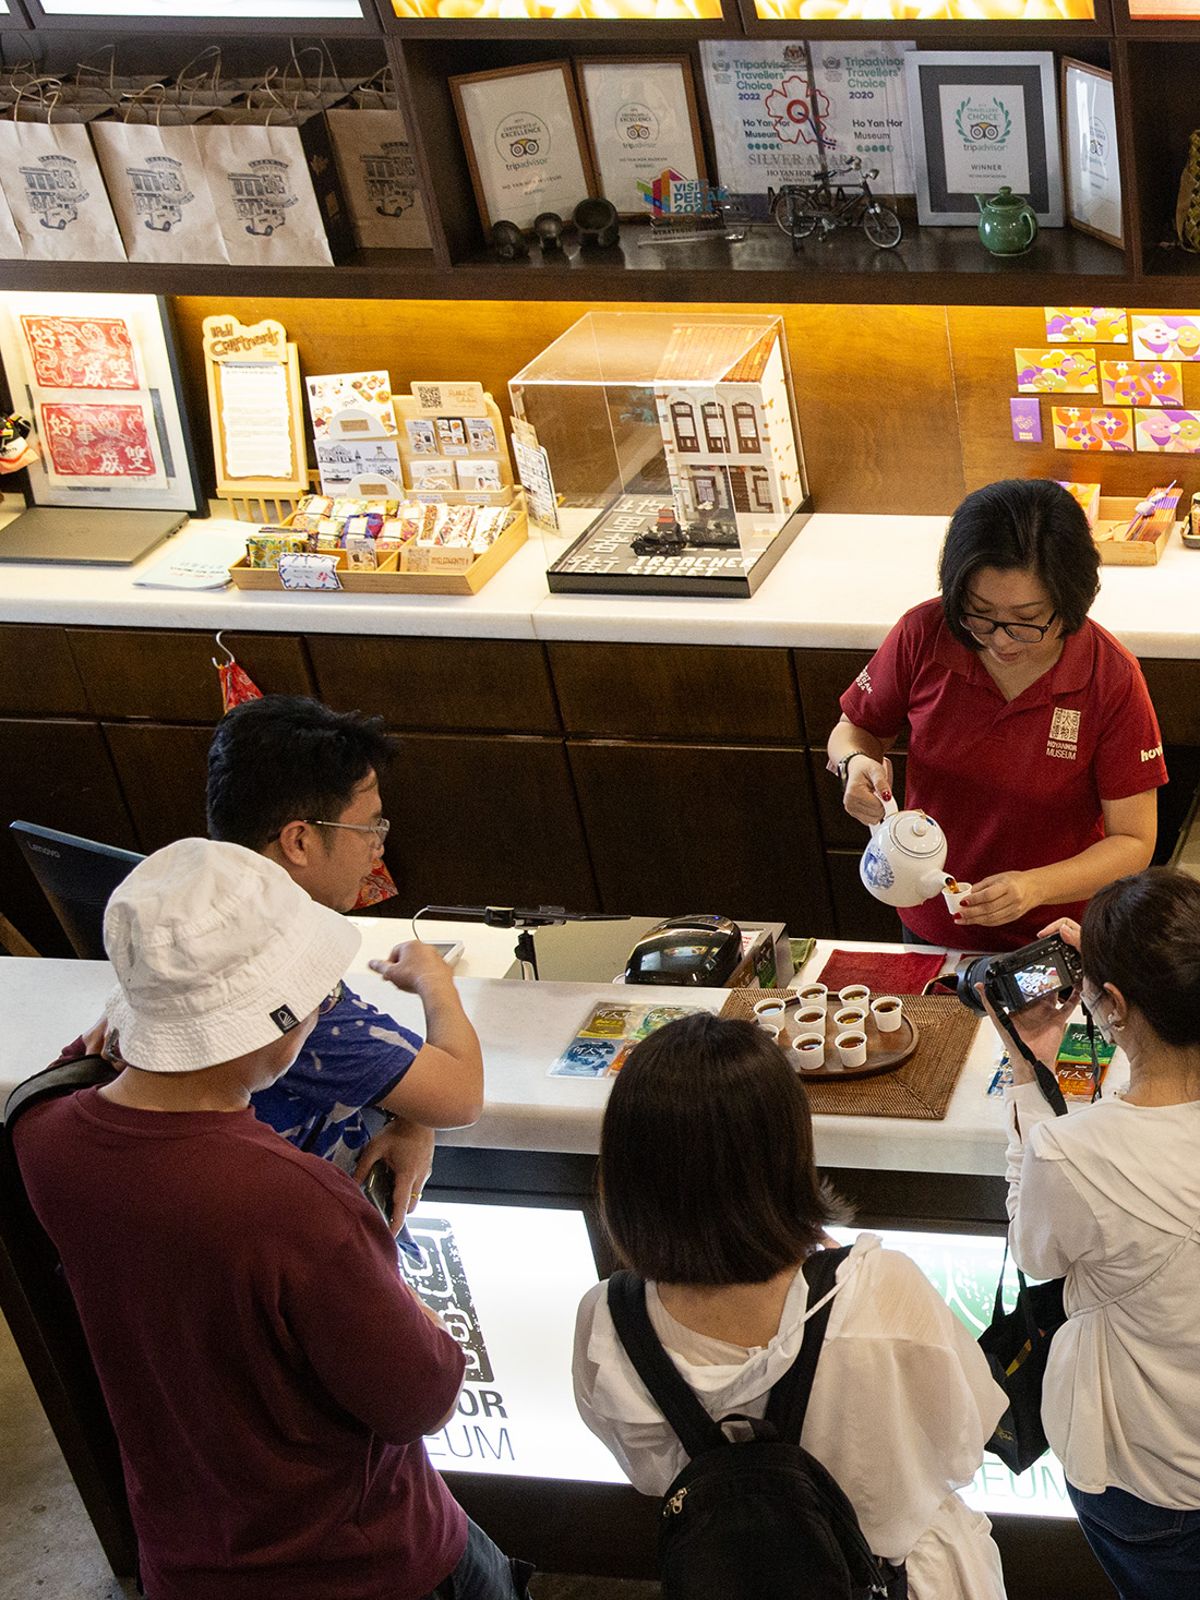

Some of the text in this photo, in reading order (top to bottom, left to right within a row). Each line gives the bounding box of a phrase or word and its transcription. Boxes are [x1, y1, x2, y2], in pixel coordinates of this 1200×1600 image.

[844, 57, 906, 67] Tripadvisor
[736, 81, 773, 91] Choice
[847, 79, 886, 88] Choice
[738, 92, 761, 101] 2022
[849, 91, 874, 99] 2020
[967, 112, 999, 121] CHOICE
[743, 119, 756, 128] Ho
[757, 119, 774, 128] Yan
[852, 119, 903, 128] Ho Yan Hor
[745, 131, 779, 139] Museum
[854, 131, 891, 140] Museum
[963, 142, 1008, 152] tripadvisor
[505, 158, 549, 171] tripadvisor
[749, 153, 804, 167] SILVER
[971, 163, 1003, 171] WINNER
[673, 181, 706, 192] VISIT
[673, 187, 729, 204] PERAK
[673, 203, 716, 214] 2024
[636, 555, 759, 568] TREACHER
[626, 566, 719, 577] STREET
[1045, 747, 1077, 761] MUSEUM
